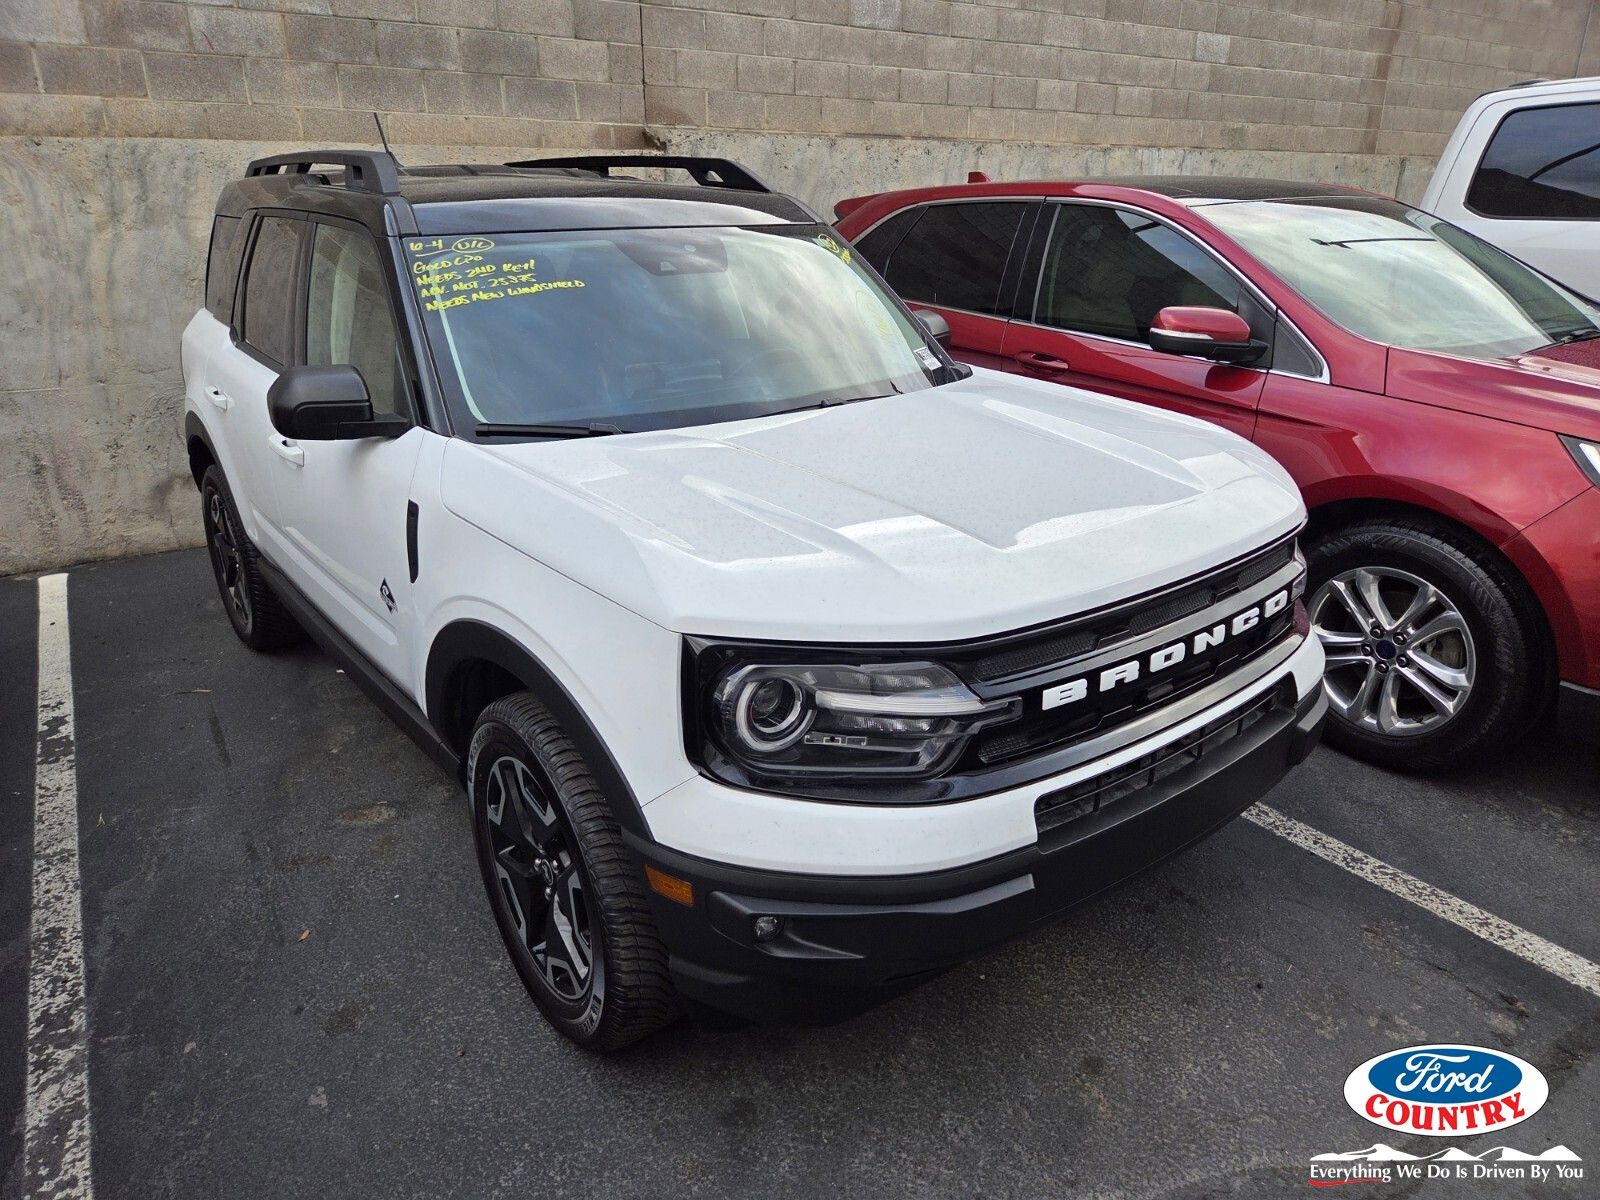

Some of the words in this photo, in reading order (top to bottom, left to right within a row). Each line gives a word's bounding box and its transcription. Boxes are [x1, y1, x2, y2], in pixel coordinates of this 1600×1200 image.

[416, 271, 462, 286] NEEDS
[465, 264, 497, 278] 2ND
[1041, 589, 1288, 711] BRONCO
